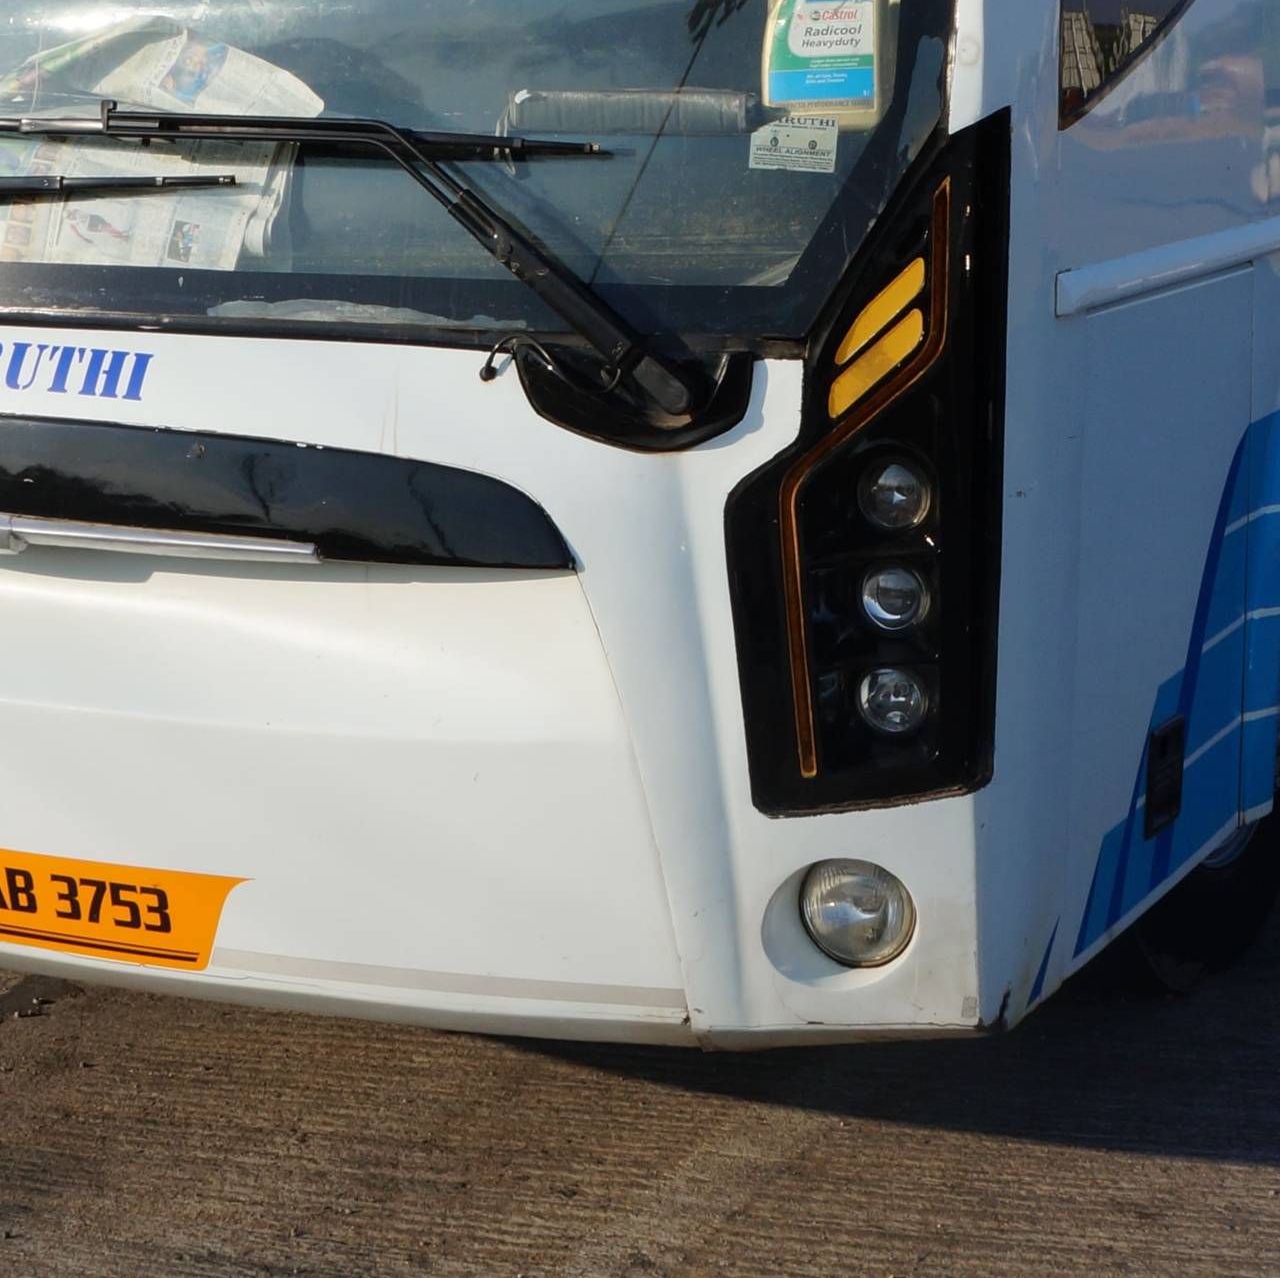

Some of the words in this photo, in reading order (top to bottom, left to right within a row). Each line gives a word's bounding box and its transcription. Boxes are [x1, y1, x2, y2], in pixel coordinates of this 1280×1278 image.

[822, 9, 858, 20] Castrol
[804, 24, 862, 36] Radicool
[801, 36, 861, 49] Heavyduty
[784, 147, 832, 157] ALIGNMENT
[50, 874, 172, 934] 3753
